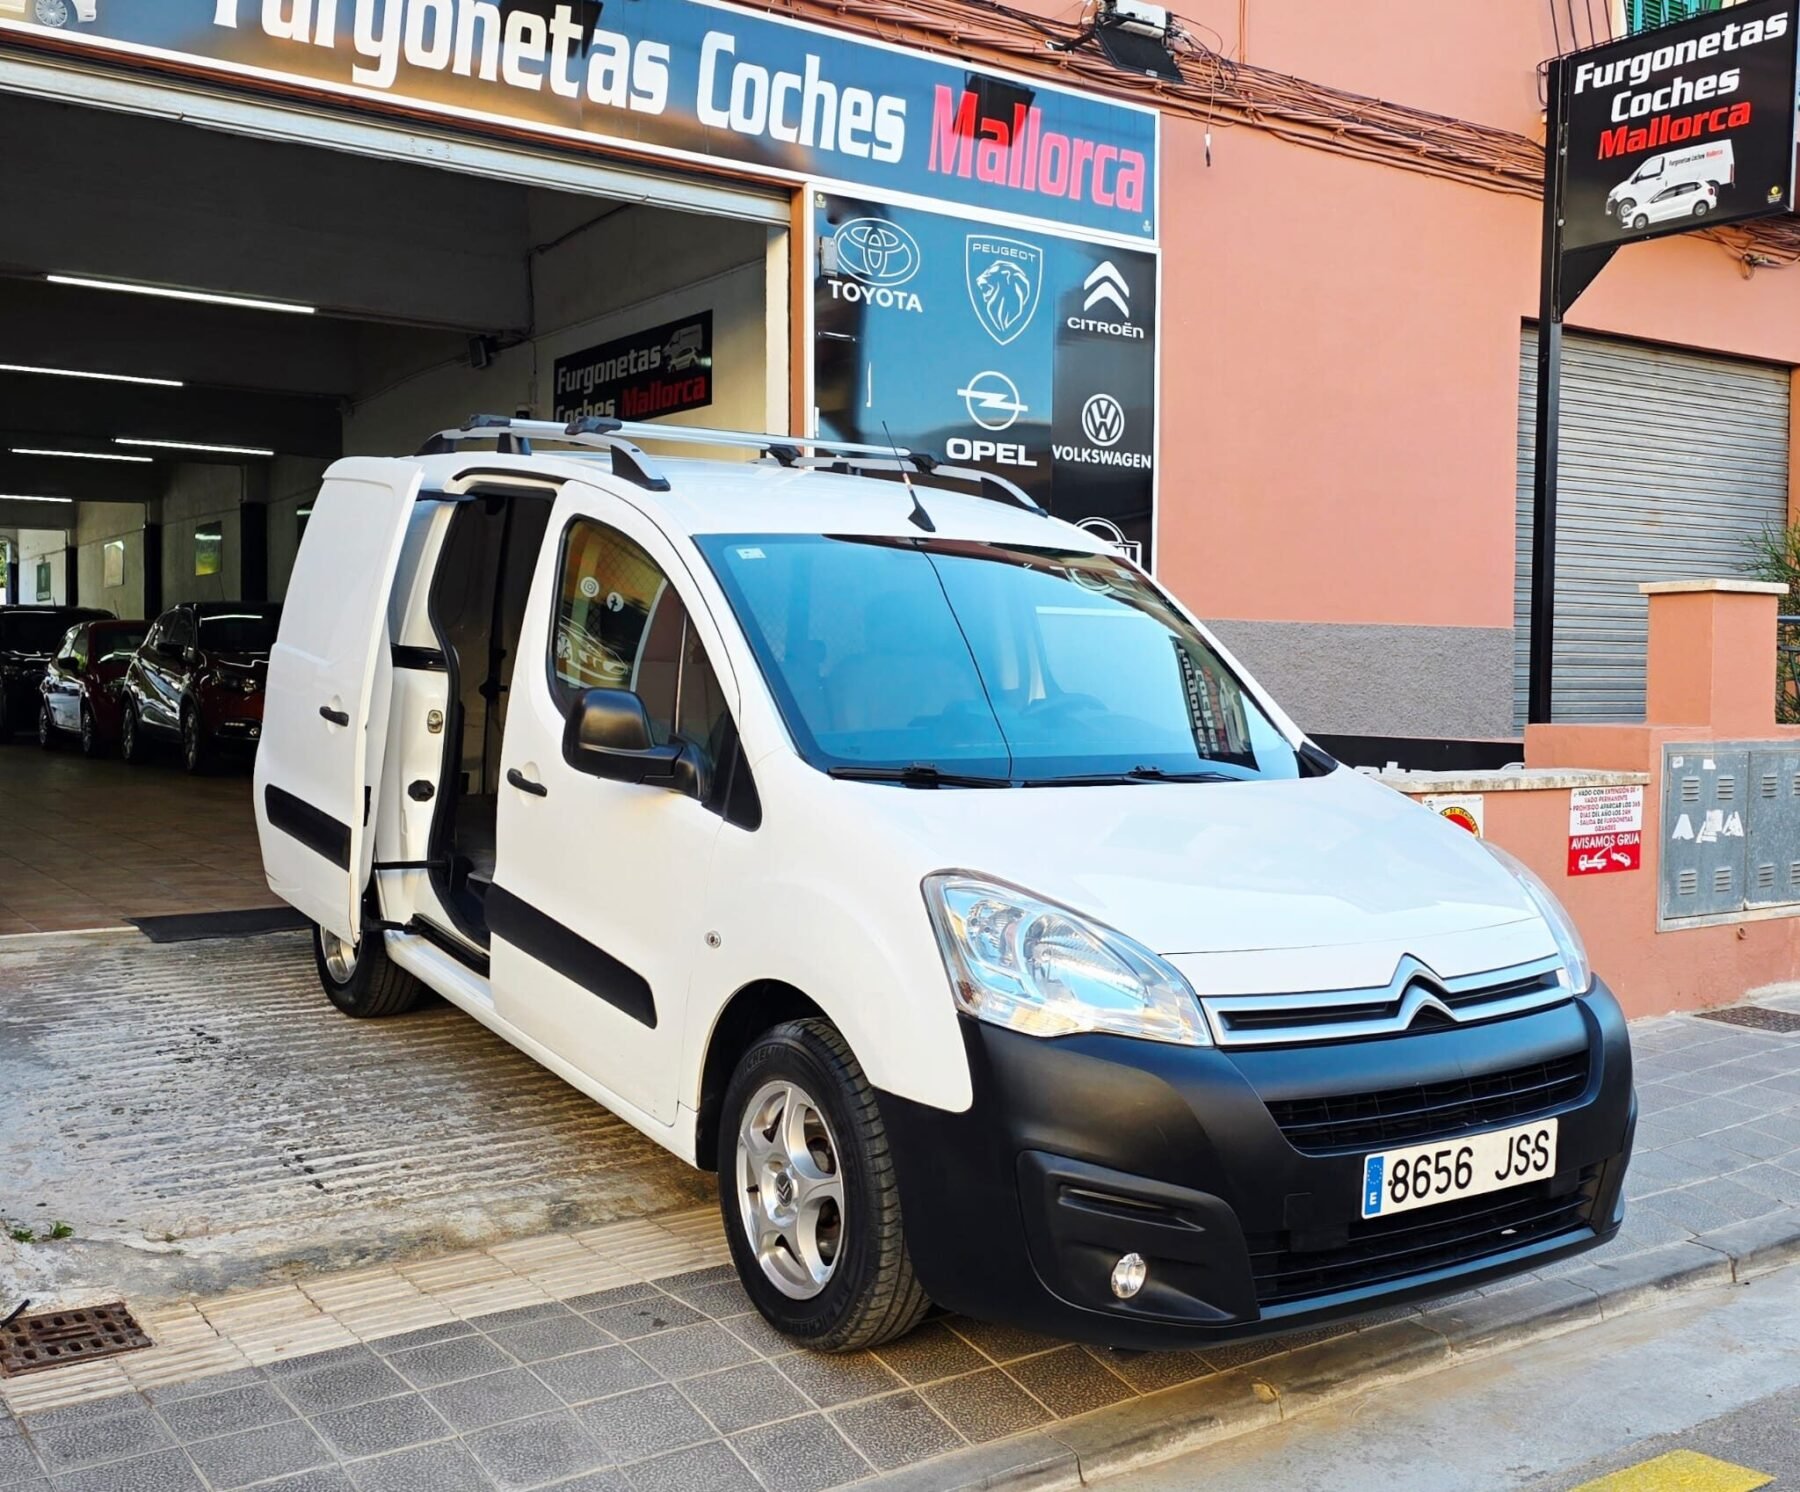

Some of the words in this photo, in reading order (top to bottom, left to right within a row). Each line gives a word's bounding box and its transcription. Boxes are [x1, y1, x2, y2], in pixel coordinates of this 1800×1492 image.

[1574, 12, 1789, 95] Furgonetas
[214, 0, 671, 116] urgonetas
[696, 31, 907, 164] Coches
[927, 83, 1147, 214] Mallorca
[1610, 67, 1740, 123] Coches
[1598, 101, 1751, 160] Mallorca
[972, 242, 1036, 263] PEUGEOT
[827, 278, 923, 313] TOYOTA
[557, 345, 661, 395] Furgonetas
[621, 376, 706, 418] Mallorca
[946, 436, 1038, 467] OPEL
[1052, 444, 1152, 469] VOLKSWAGEN
[1571, 834, 1616, 850] AVISAMOS
[1616, 832, 1640, 846] GRUA
[1390, 1146, 1473, 1204] 8656
[1495, 1129, 1549, 1180] JSS
[1369, 1191, 1377, 1205] E
